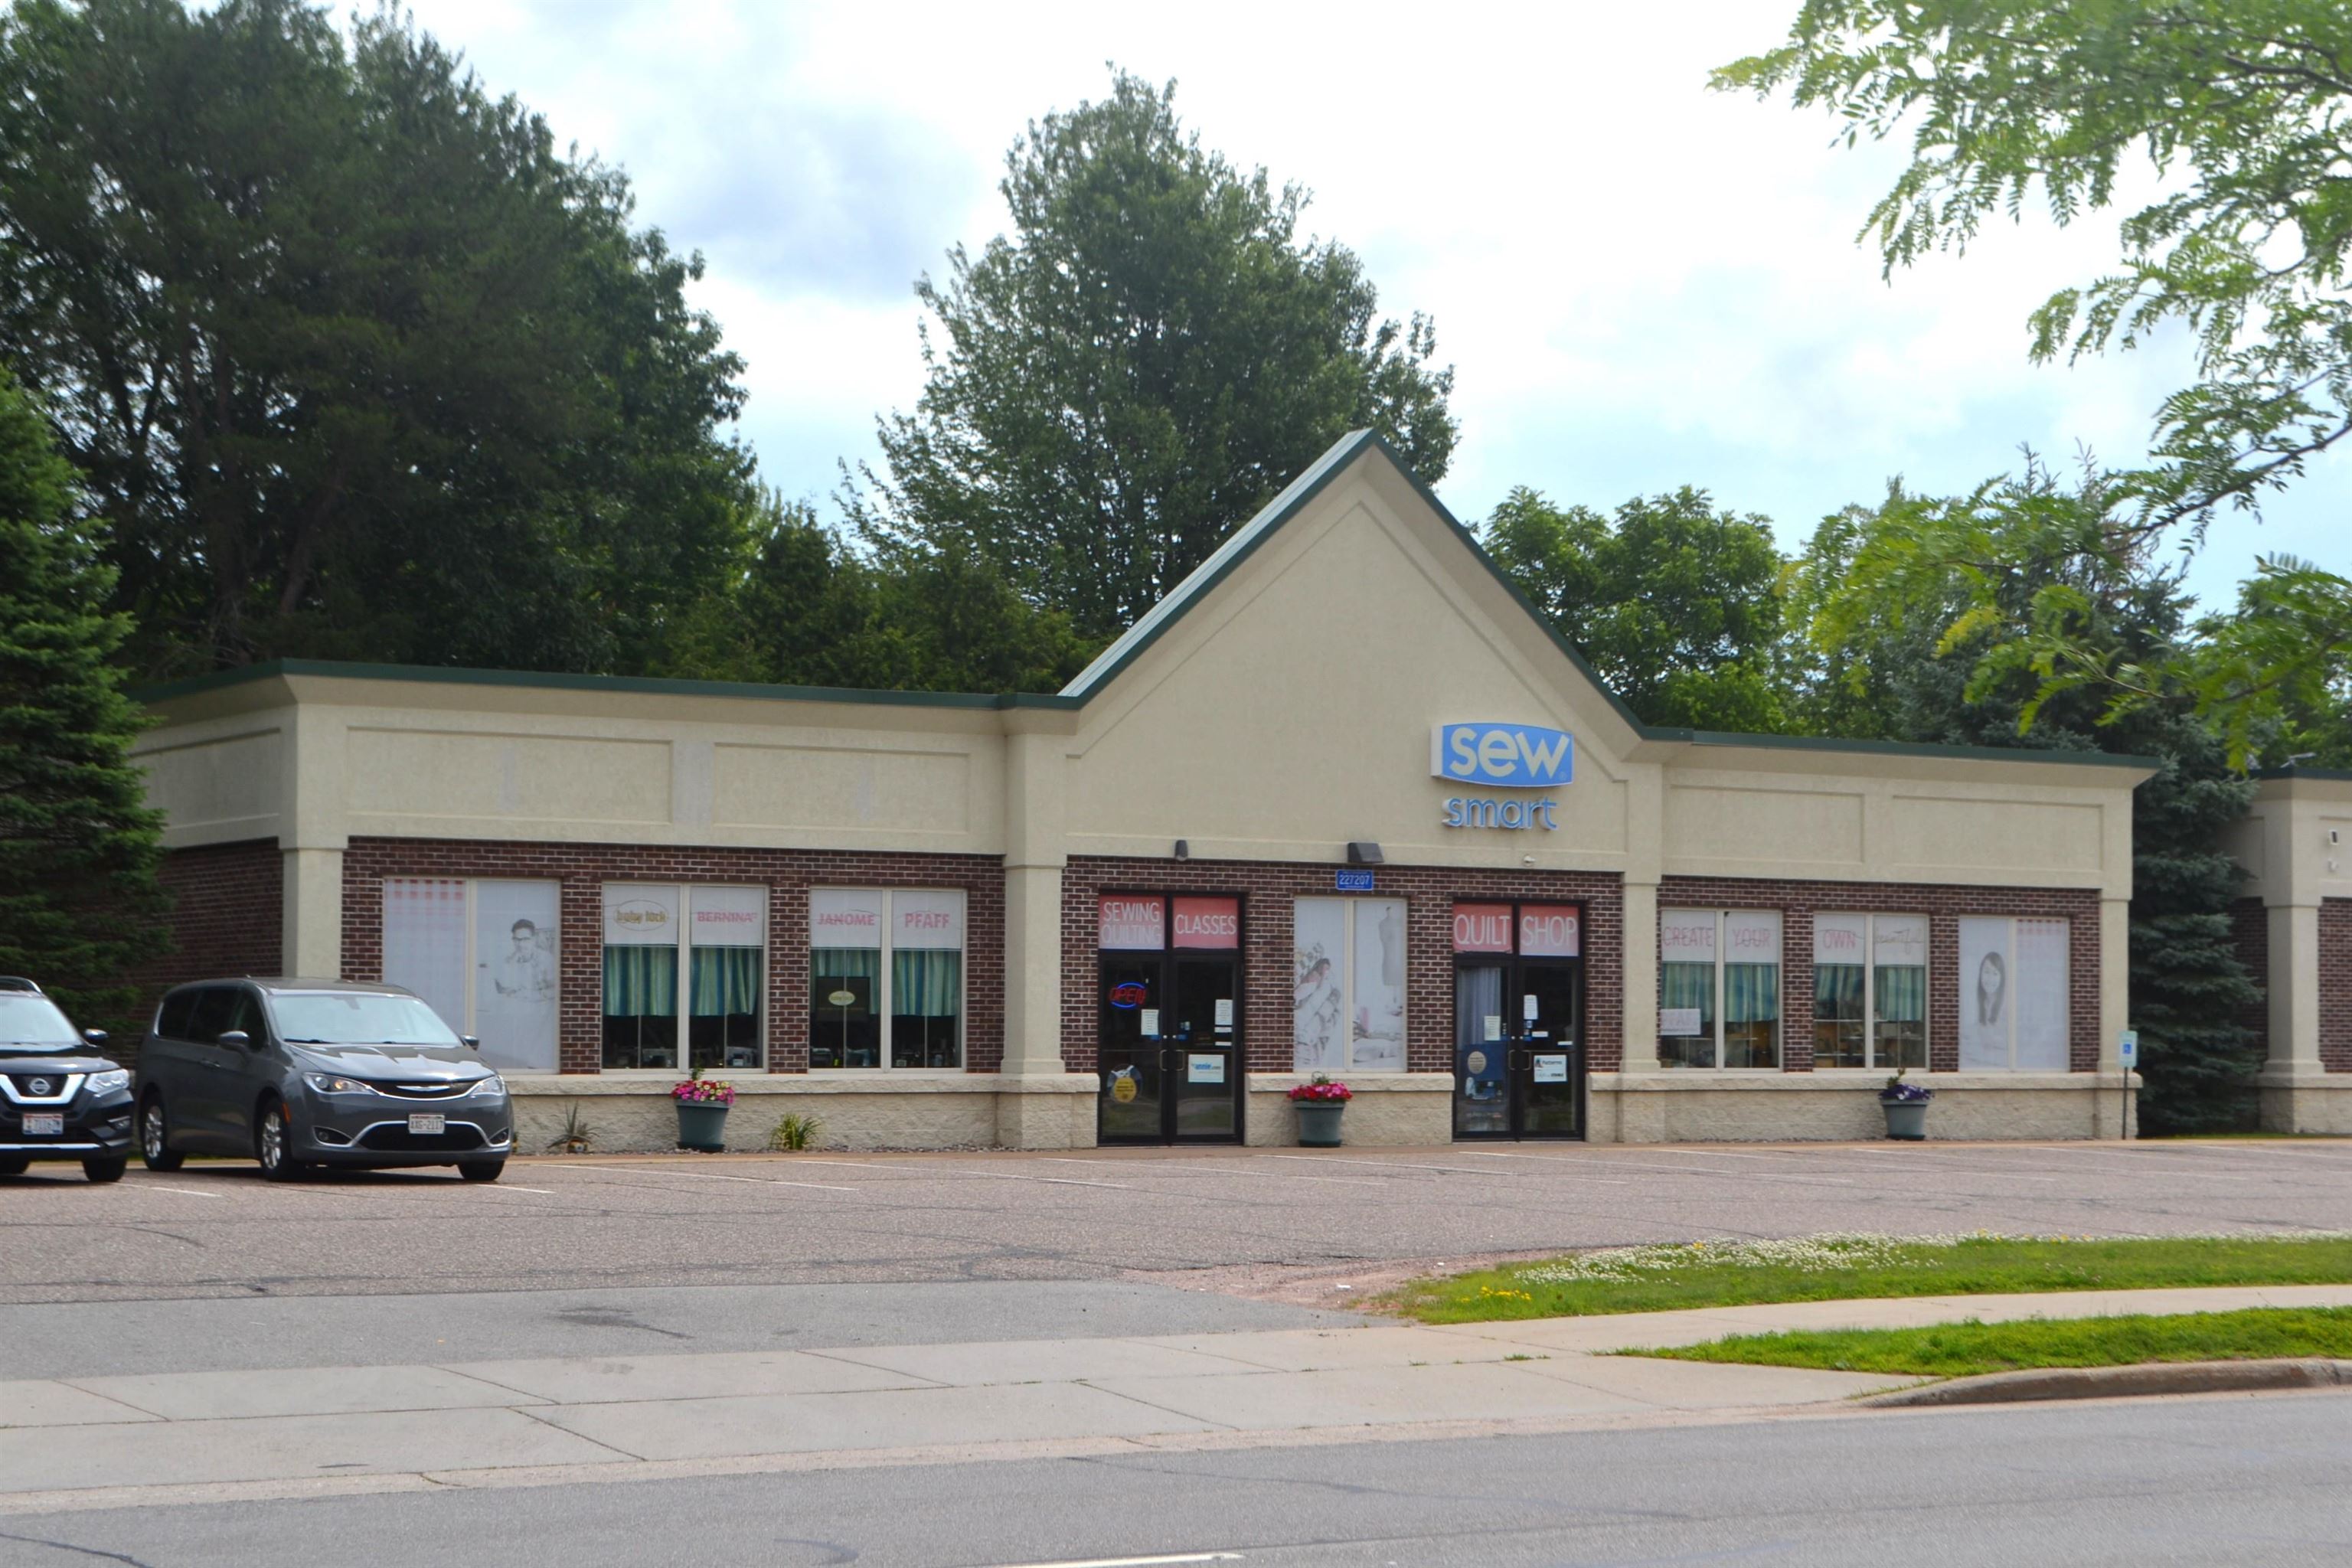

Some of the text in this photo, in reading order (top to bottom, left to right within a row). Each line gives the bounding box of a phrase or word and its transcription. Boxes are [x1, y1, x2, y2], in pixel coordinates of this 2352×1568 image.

[1449, 727, 1570, 779] sew
[1442, 796, 1558, 830] smart
[817, 913, 875, 926] JANOME
[904, 913, 950, 929] PFAFF
[1103, 902, 1160, 923] SEWING
[1101, 925, 1161, 945] QUILTING
[1174, 914, 1237, 935] CLASSES
[1455, 914, 1511, 946] QUILT
[1521, 916, 1577, 946] SHOP
[1662, 926, 1714, 947] CREATE
[1733, 928, 1772, 948] YOUR
[1823, 929, 1856, 949] OWN
[1110, 987, 1145, 1004] OPEN
